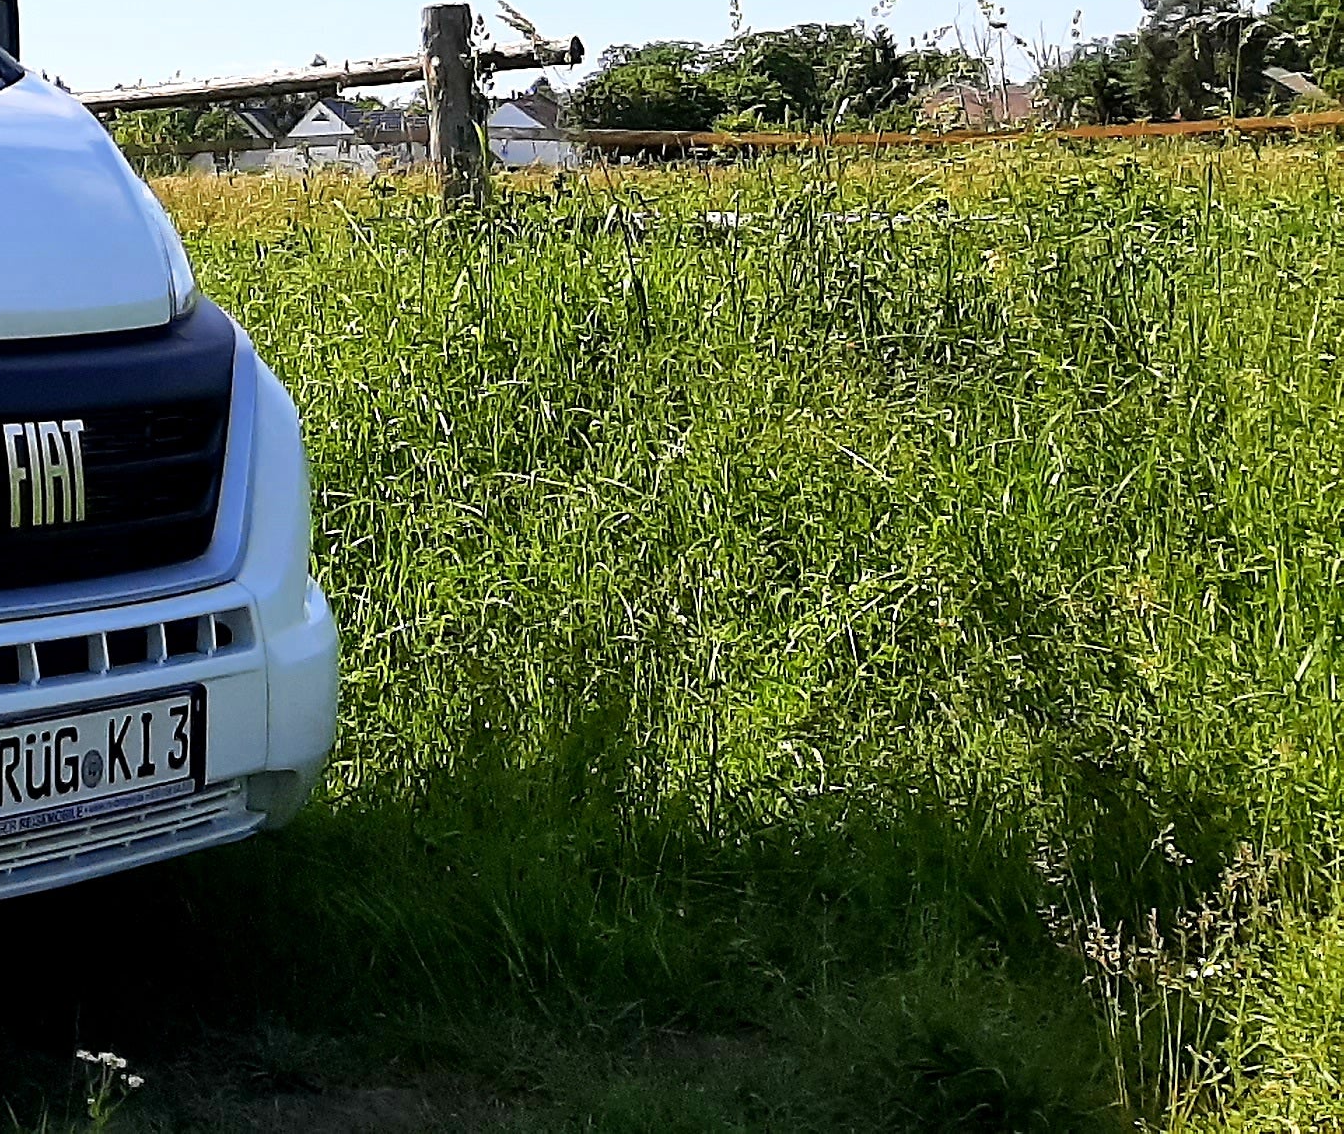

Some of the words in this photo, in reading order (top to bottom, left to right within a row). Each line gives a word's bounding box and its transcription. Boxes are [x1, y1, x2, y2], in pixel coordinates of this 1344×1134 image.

[3, 419, 85, 528] FIAT
[108, 710, 156, 784] KI
[166, 704, 190, 770] 3
